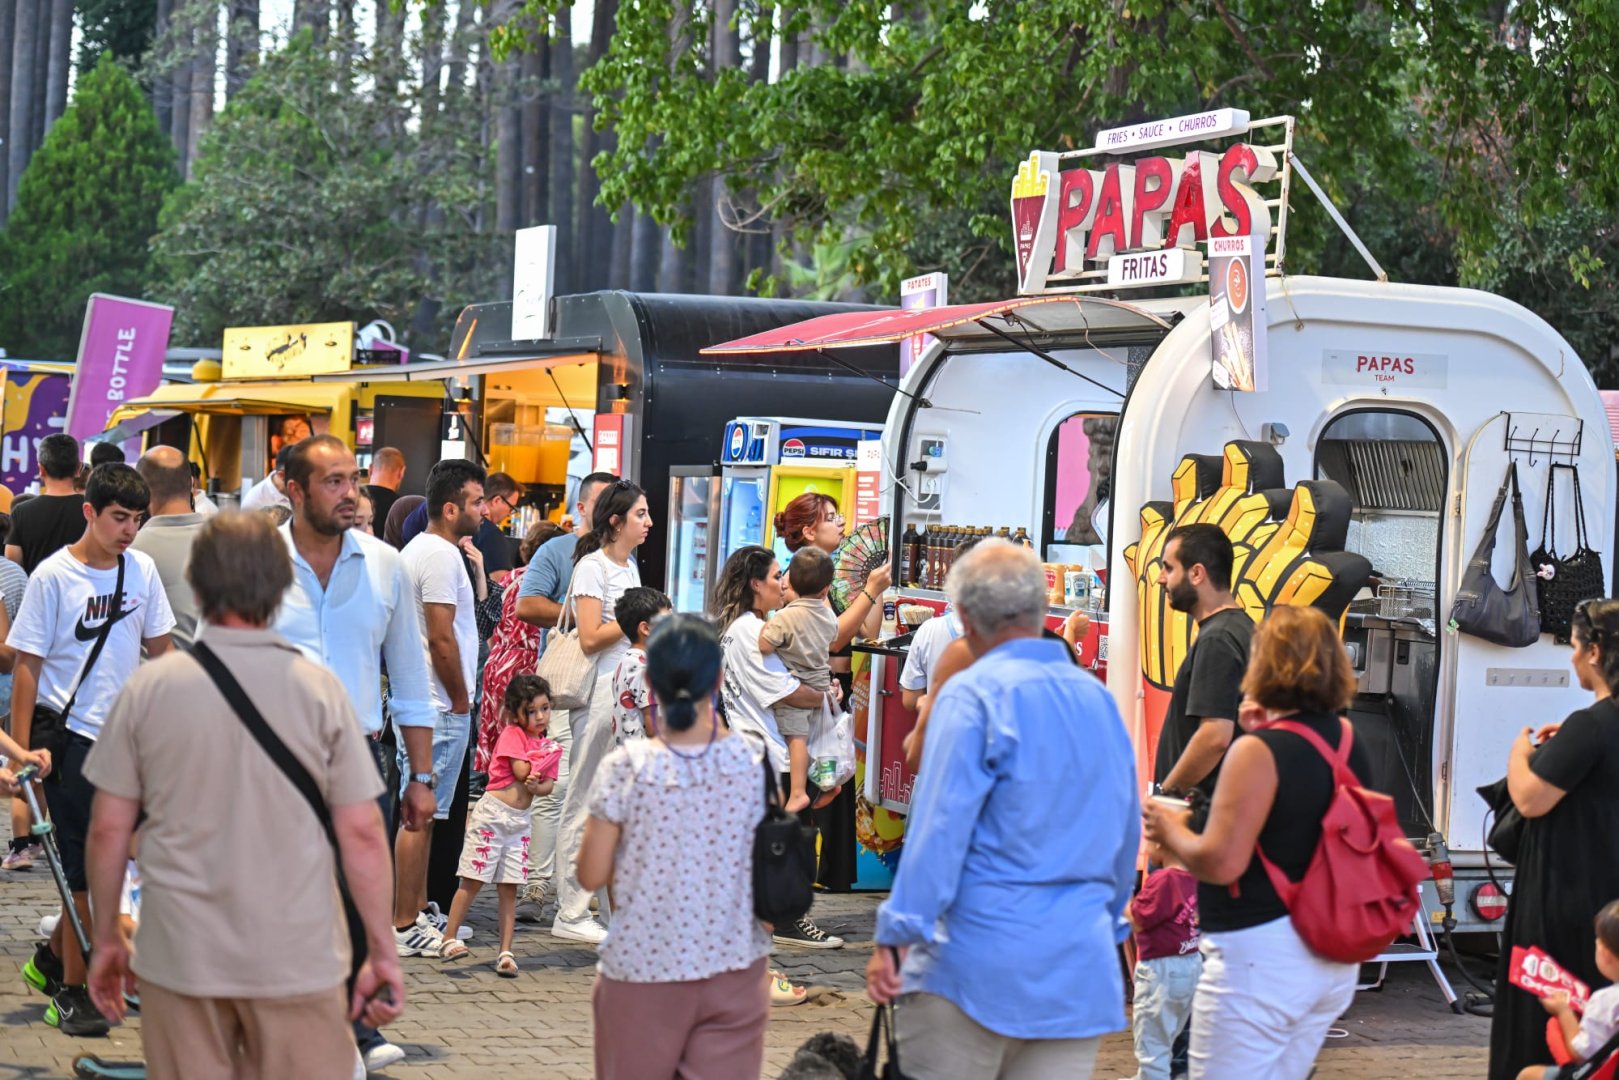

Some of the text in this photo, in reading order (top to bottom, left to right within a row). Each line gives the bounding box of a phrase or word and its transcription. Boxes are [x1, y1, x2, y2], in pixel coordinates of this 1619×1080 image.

[1107, 114, 1218, 145] FRIES SAUCE CHURROS
[1054, 142, 1259, 274] PAPAS
[1213, 238, 1245, 252] CHURROS
[1122, 254, 1168, 280] FRITAS
[907, 277, 932, 290] PATATES
[107, 327, 136, 401] BOTTLE
[1356, 355, 1415, 375] PAPAS
[1374, 374, 1395, 382] TEAM
